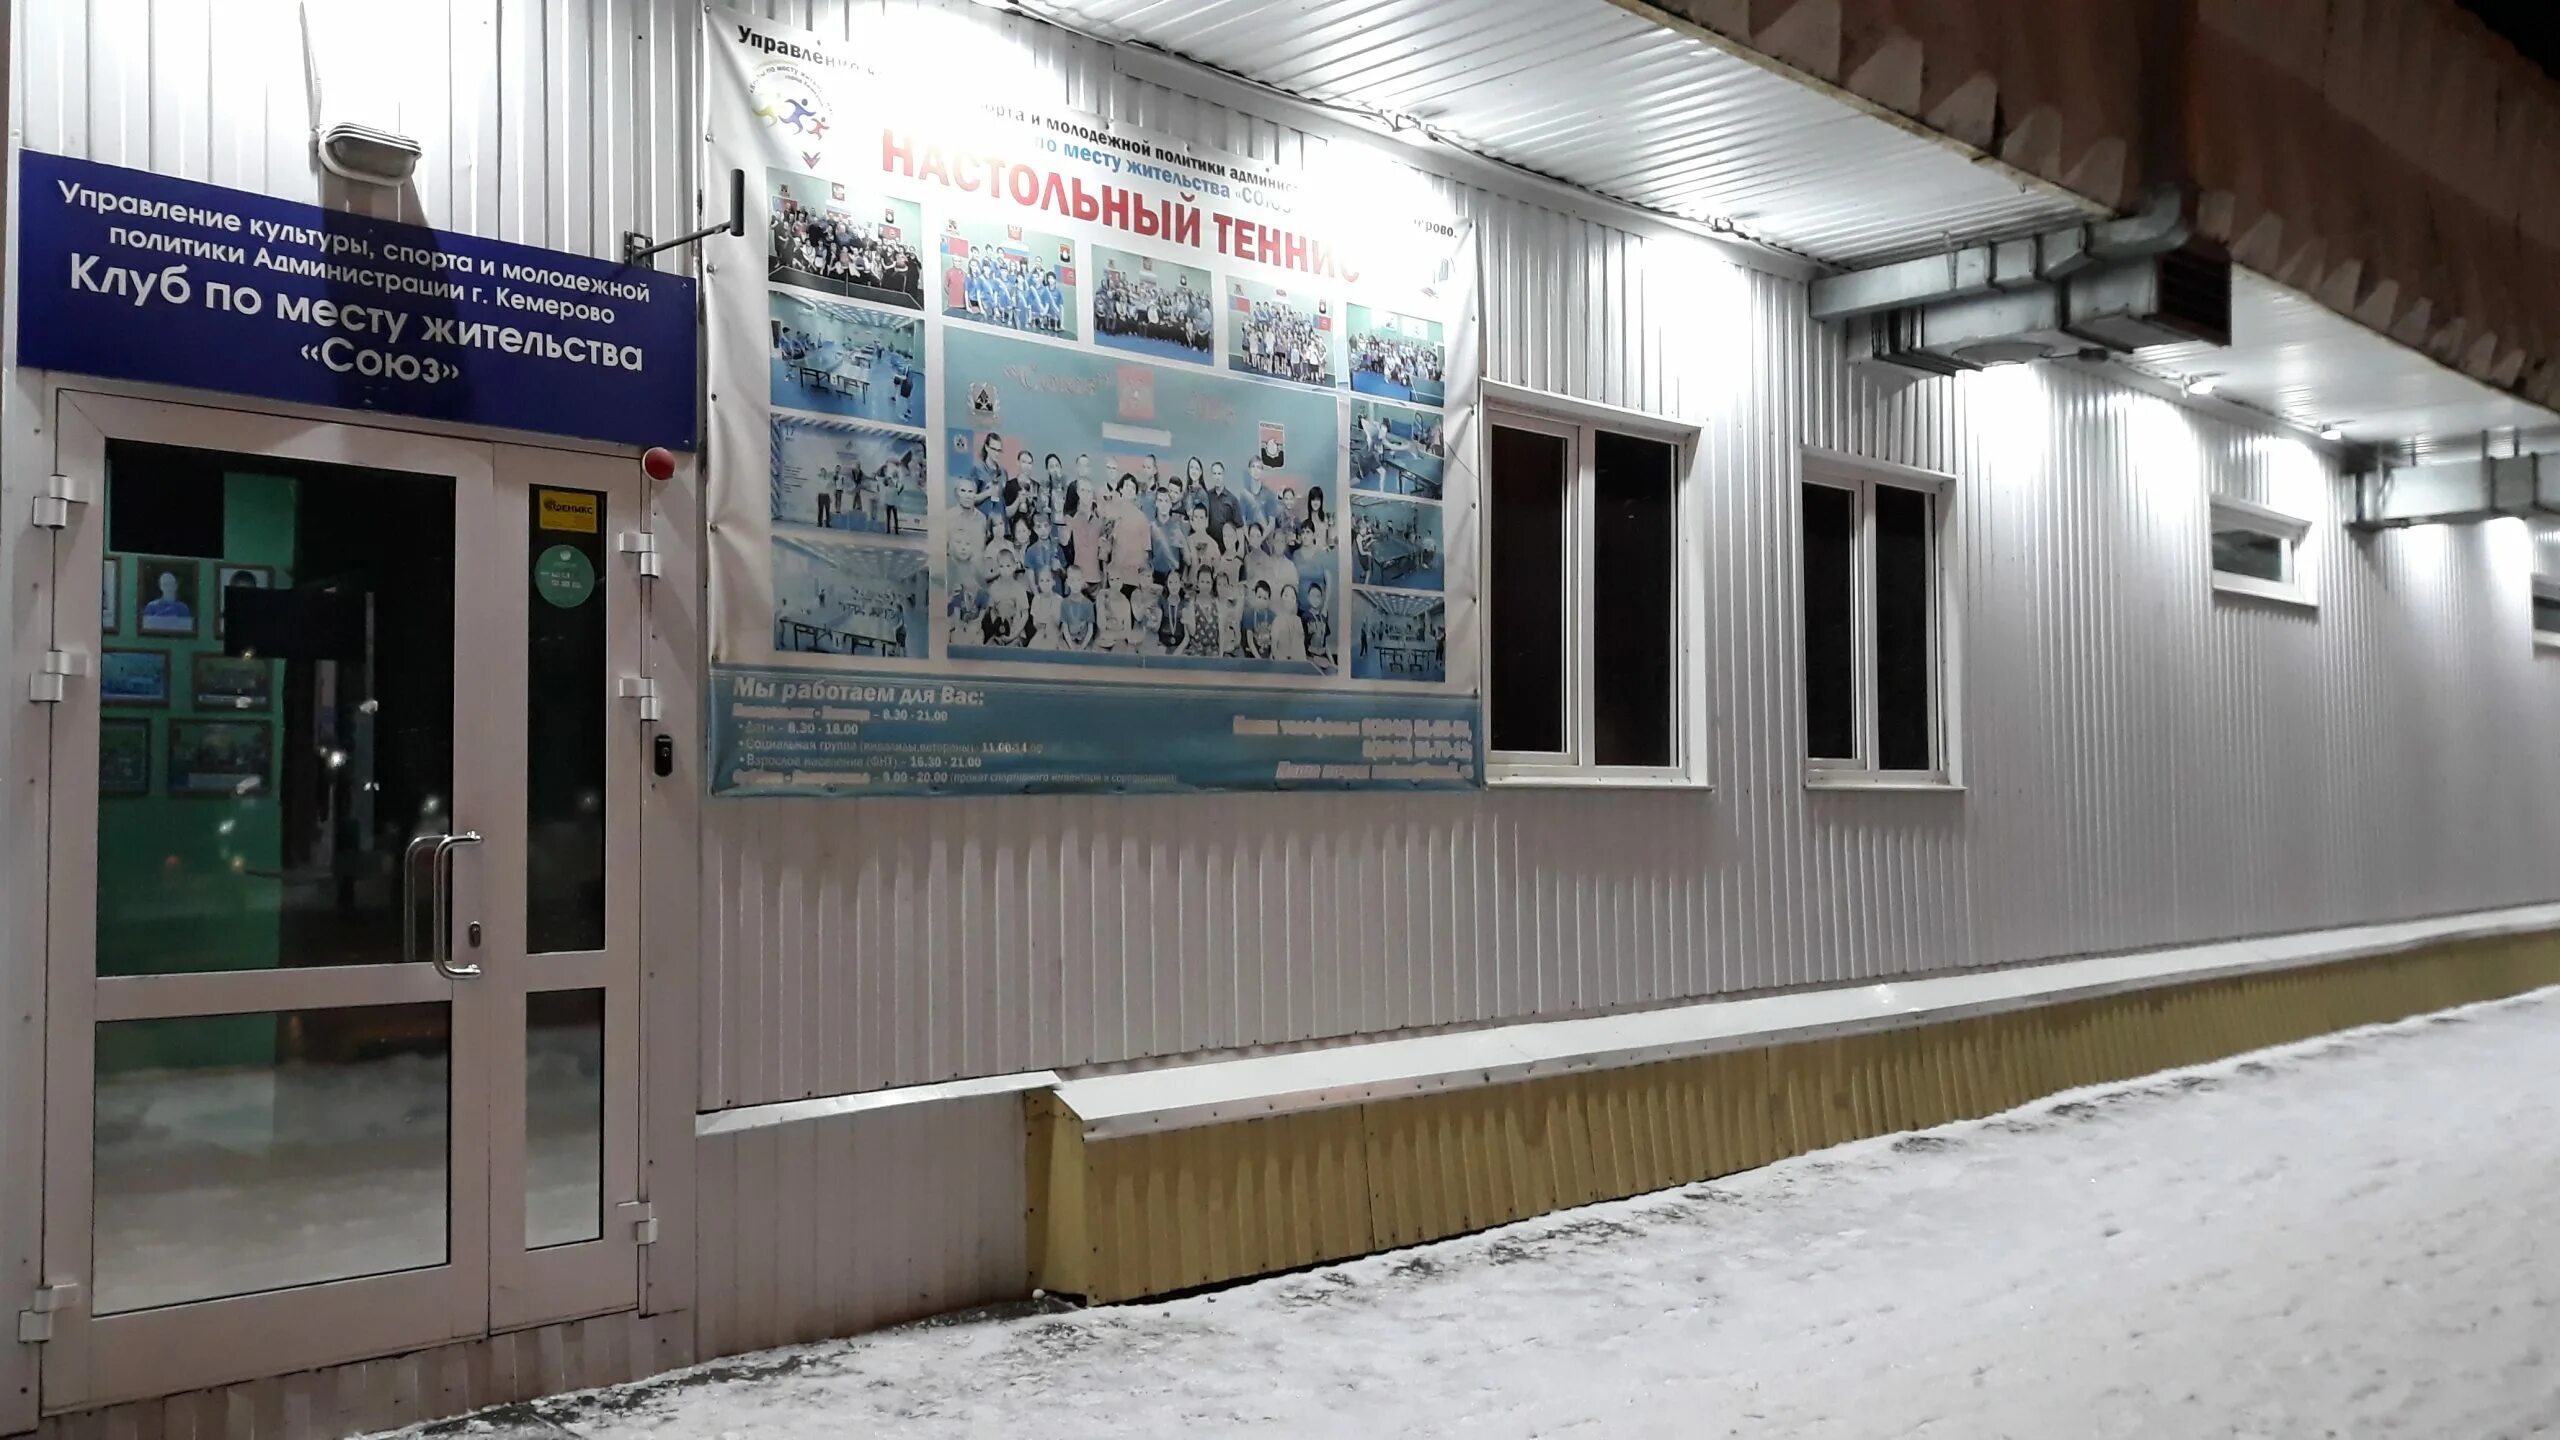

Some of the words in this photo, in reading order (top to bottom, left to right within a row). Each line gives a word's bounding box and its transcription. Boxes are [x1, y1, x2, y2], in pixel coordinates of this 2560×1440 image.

[1031, 114, 1040, 125] и
[1046, 117, 1151, 157] молодежной
[1155, 146, 1226, 177] политики
[1063, 143, 1121, 173] месту
[1126, 159, 1231, 199] жительства
[882, 128, 1200, 248] НАСТОЛЬНЫЙ
[57, 179, 242, 232] Управление
[249, 217, 375, 260] культуры,
[383, 243, 473, 273] спорта
[480, 259, 495, 277] и
[502, 263, 650, 303] молодежной
[110, 226, 245, 265] политики
[253, 247, 465, 301] Администрации
[472, 287, 488, 304] г.
[496, 287, 616, 325] Кемерово
[71, 252, 191, 307] Клуб
[206, 281, 262, 316] по
[276, 292, 408, 344] месту
[421, 314, 643, 372] жительства
[300, 336, 460, 384] «Союз»
[733, 676, 775, 698] Мы
[781, 680, 894, 704] работаем
[900, 687, 936, 705] для
[940, 686, 985, 706] Вас:
[917, 710, 948, 722] 21.00
[787, 723, 815, 734] 8.30
[825, 723, 858, 735] 18.00
[910, 756, 941, 768] 16.30
[951, 757, 982, 768] 21.00
